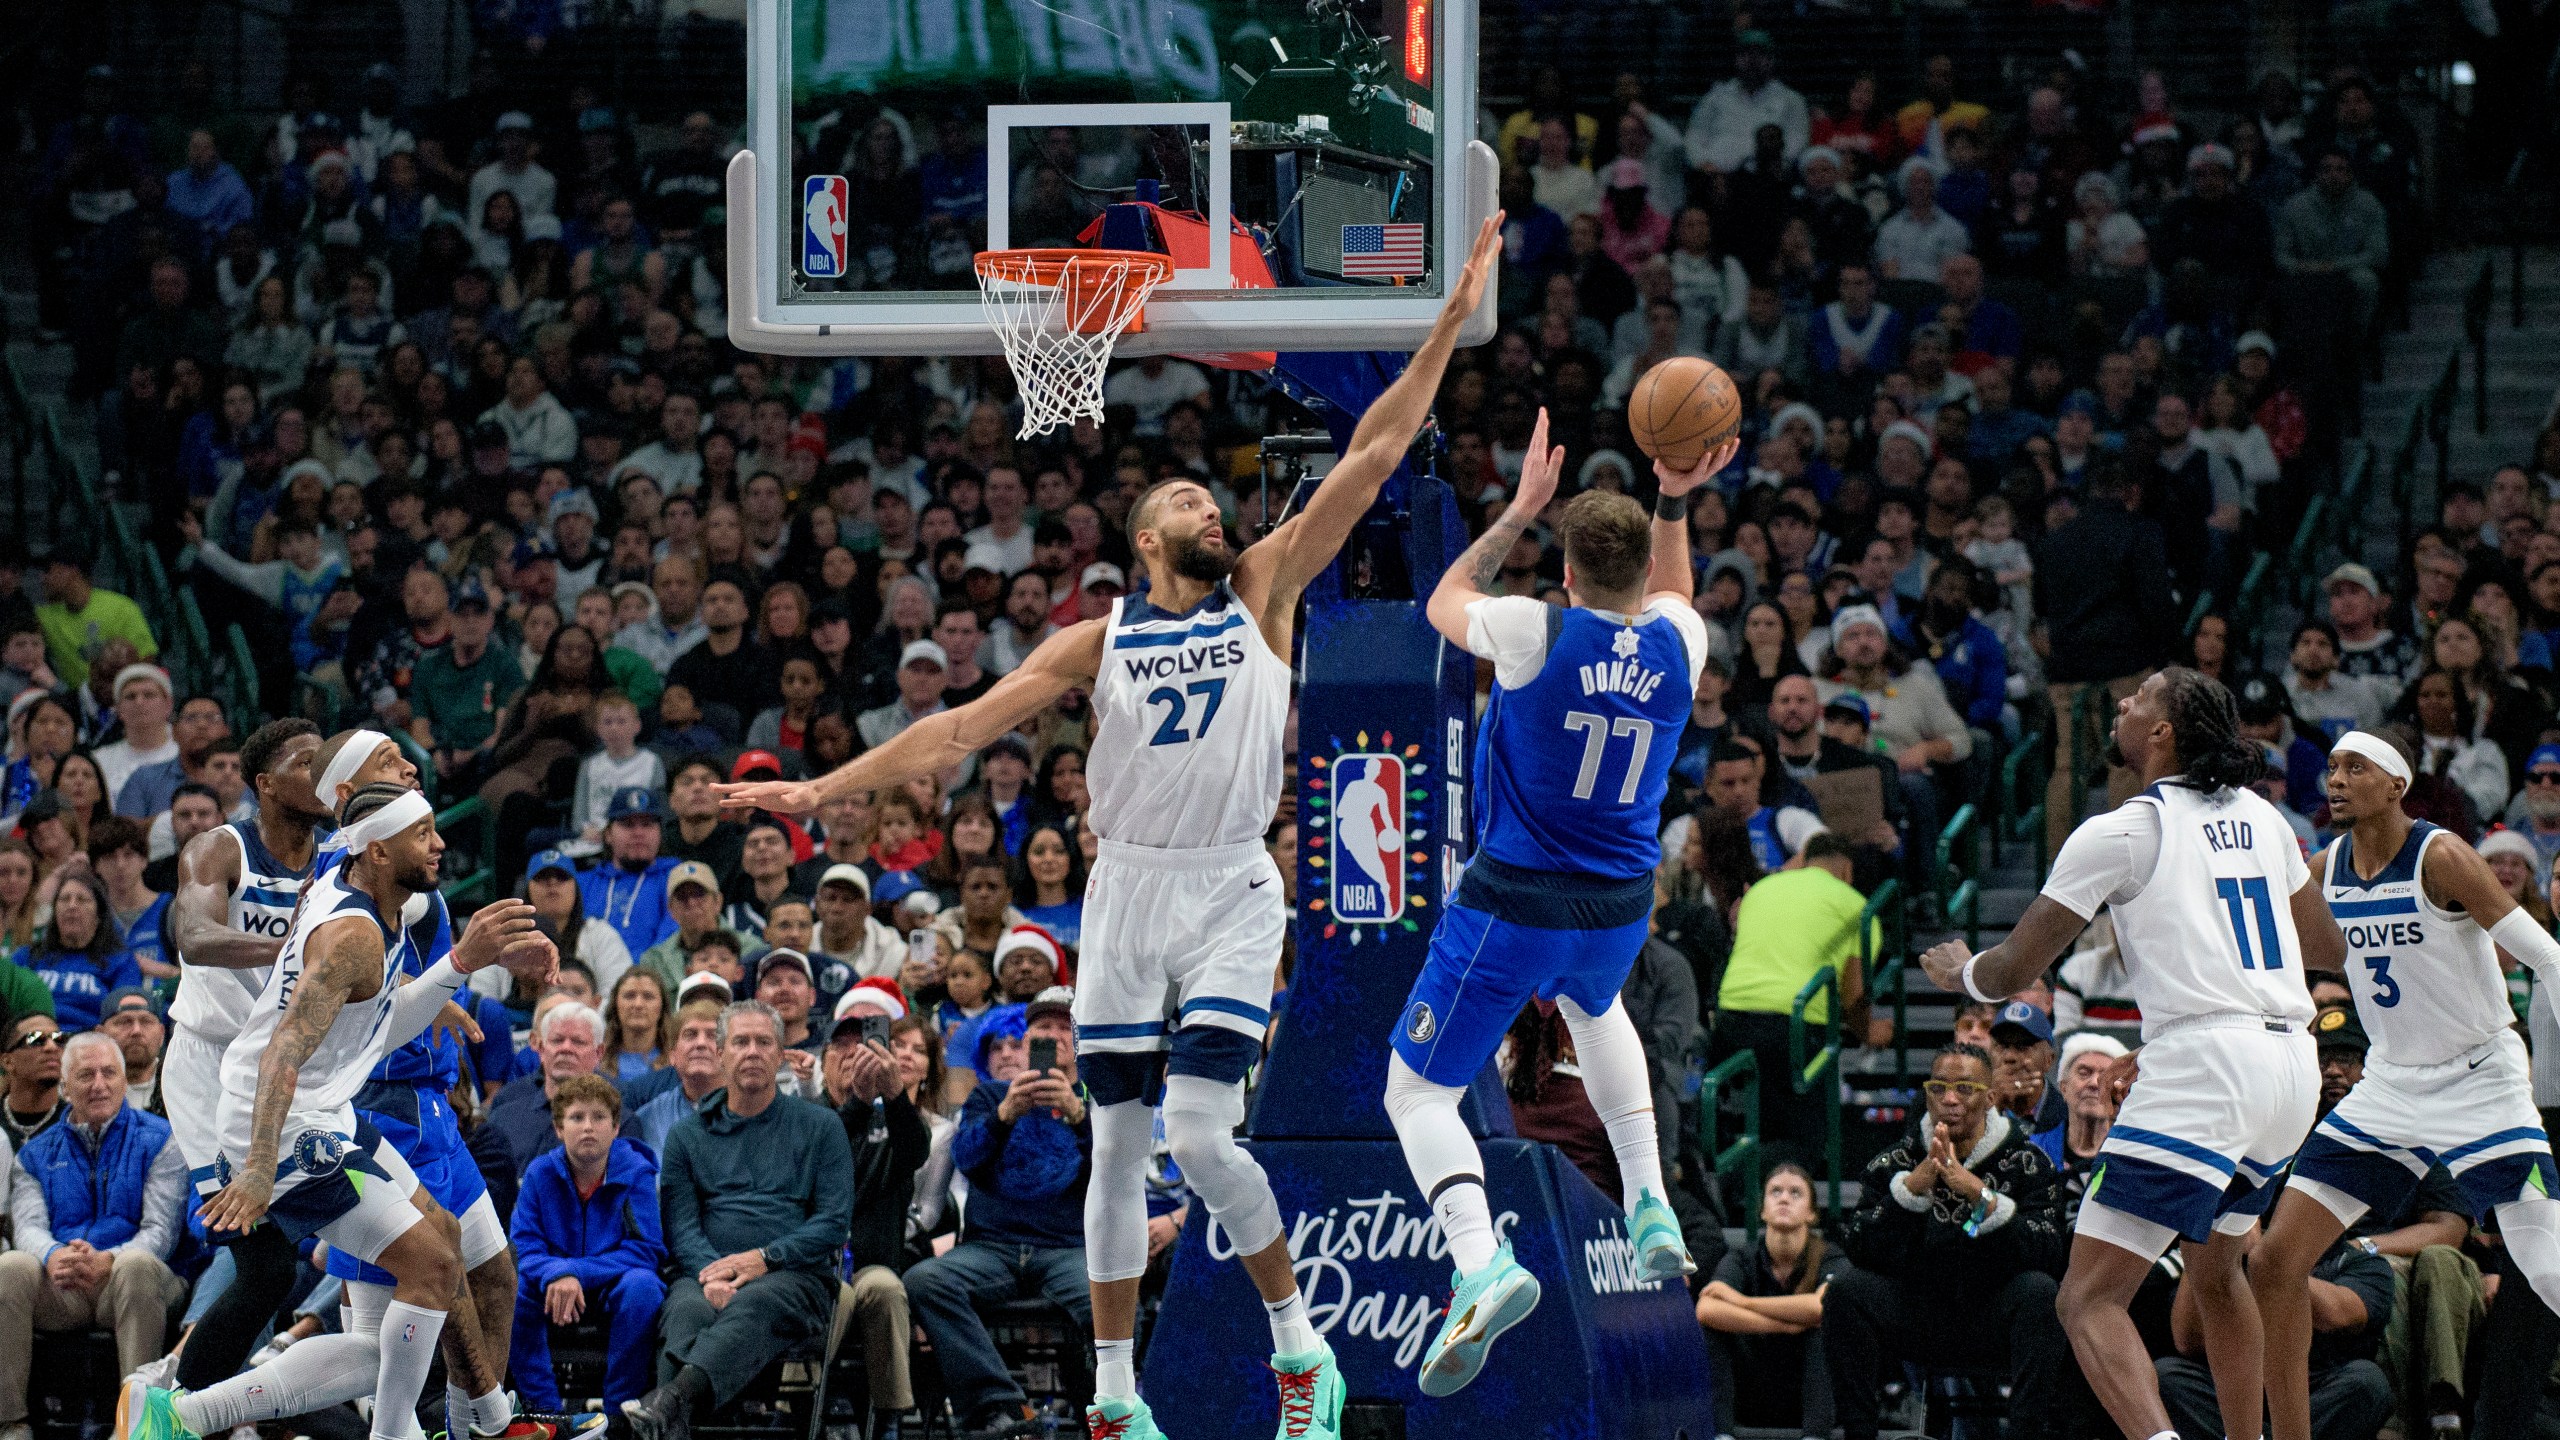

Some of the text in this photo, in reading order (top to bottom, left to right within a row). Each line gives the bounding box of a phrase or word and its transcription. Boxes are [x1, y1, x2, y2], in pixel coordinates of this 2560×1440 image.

[809, 254, 830, 271] NBA
[1125, 640, 1245, 683] WOLVES
[1579, 657, 1666, 703] DONČIĆ
[1146, 677, 1227, 746] 27
[1447, 717, 1464, 778] GET
[1564, 711, 1653, 803] 77
[1446, 780, 1464, 842] THE
[2203, 820, 2253, 852] REID
[1342, 884, 1377, 911] NBA
[2387, 886, 2411, 894] sezzle
[2215, 876, 2284, 970] 11
[2363, 955, 2400, 1008] 3
[1585, 1217, 1662, 1294] coinba
[1291, 1255, 1444, 1369] Day
